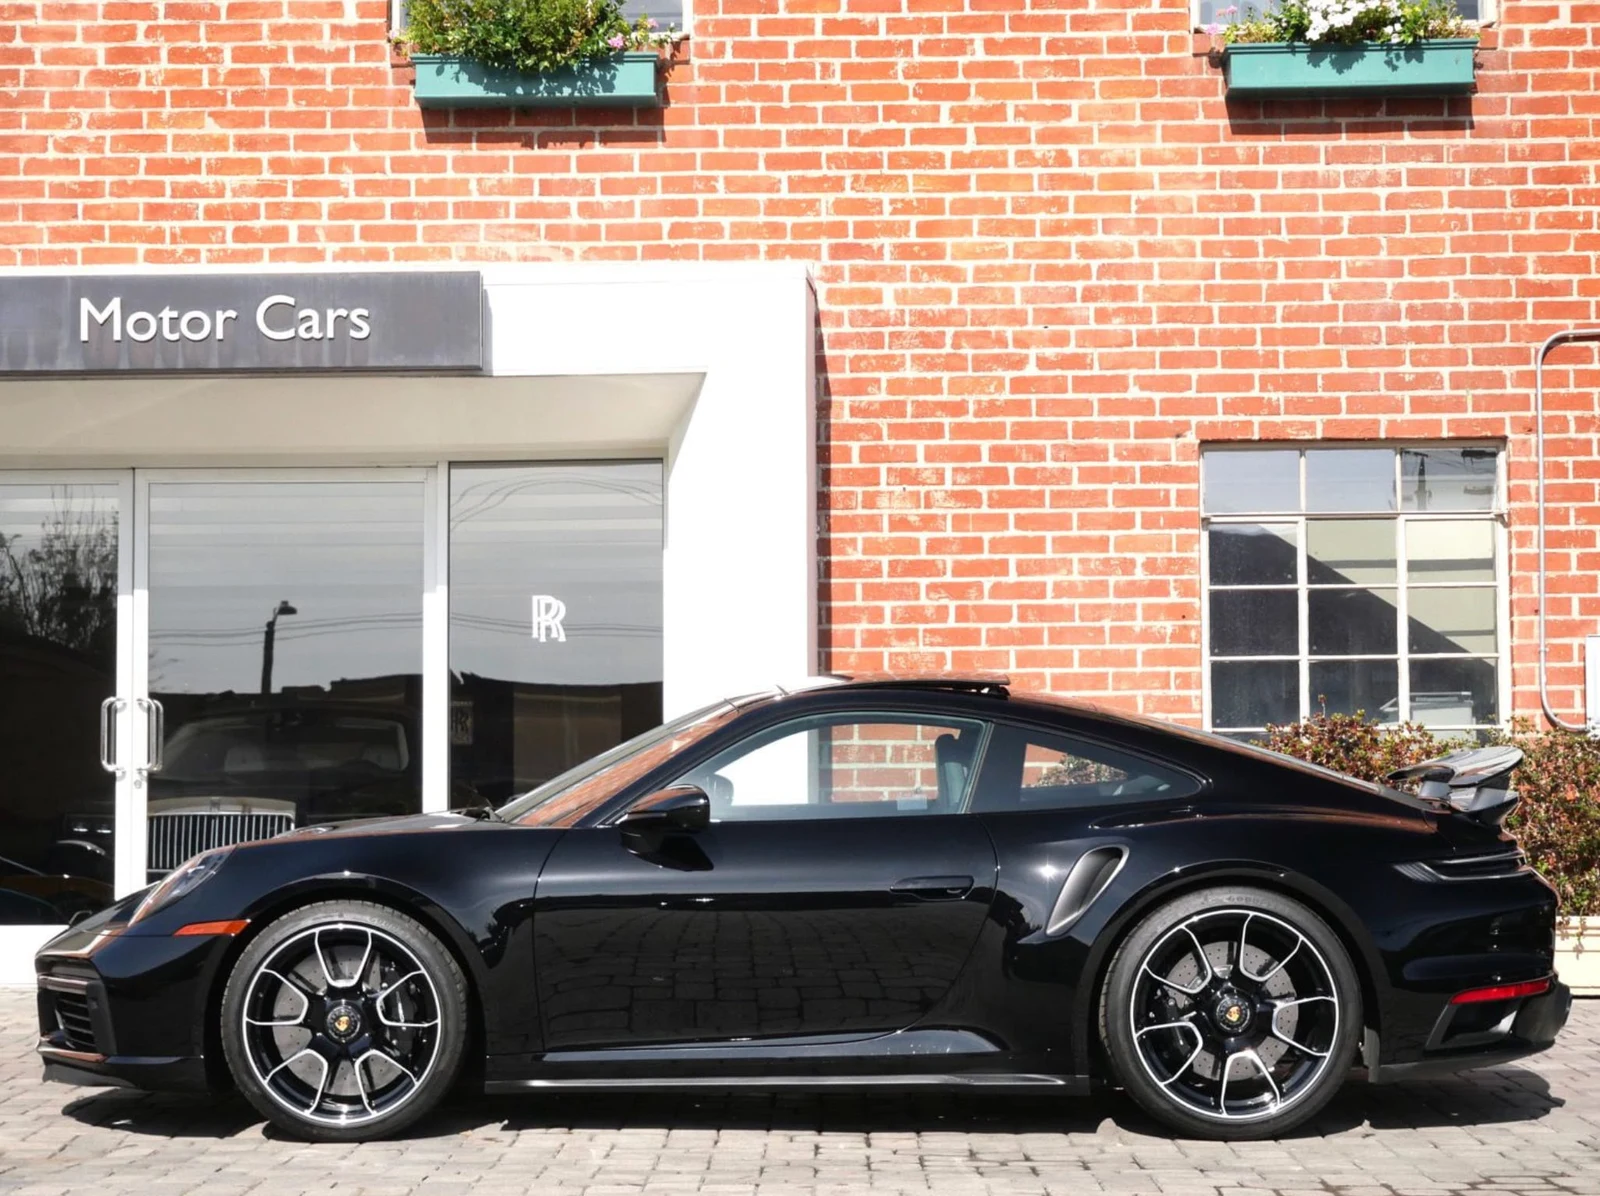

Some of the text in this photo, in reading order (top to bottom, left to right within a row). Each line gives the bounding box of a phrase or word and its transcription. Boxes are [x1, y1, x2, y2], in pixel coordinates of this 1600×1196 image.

[80, 294, 371, 342] Motor Cars
[531, 594, 567, 643] RR
